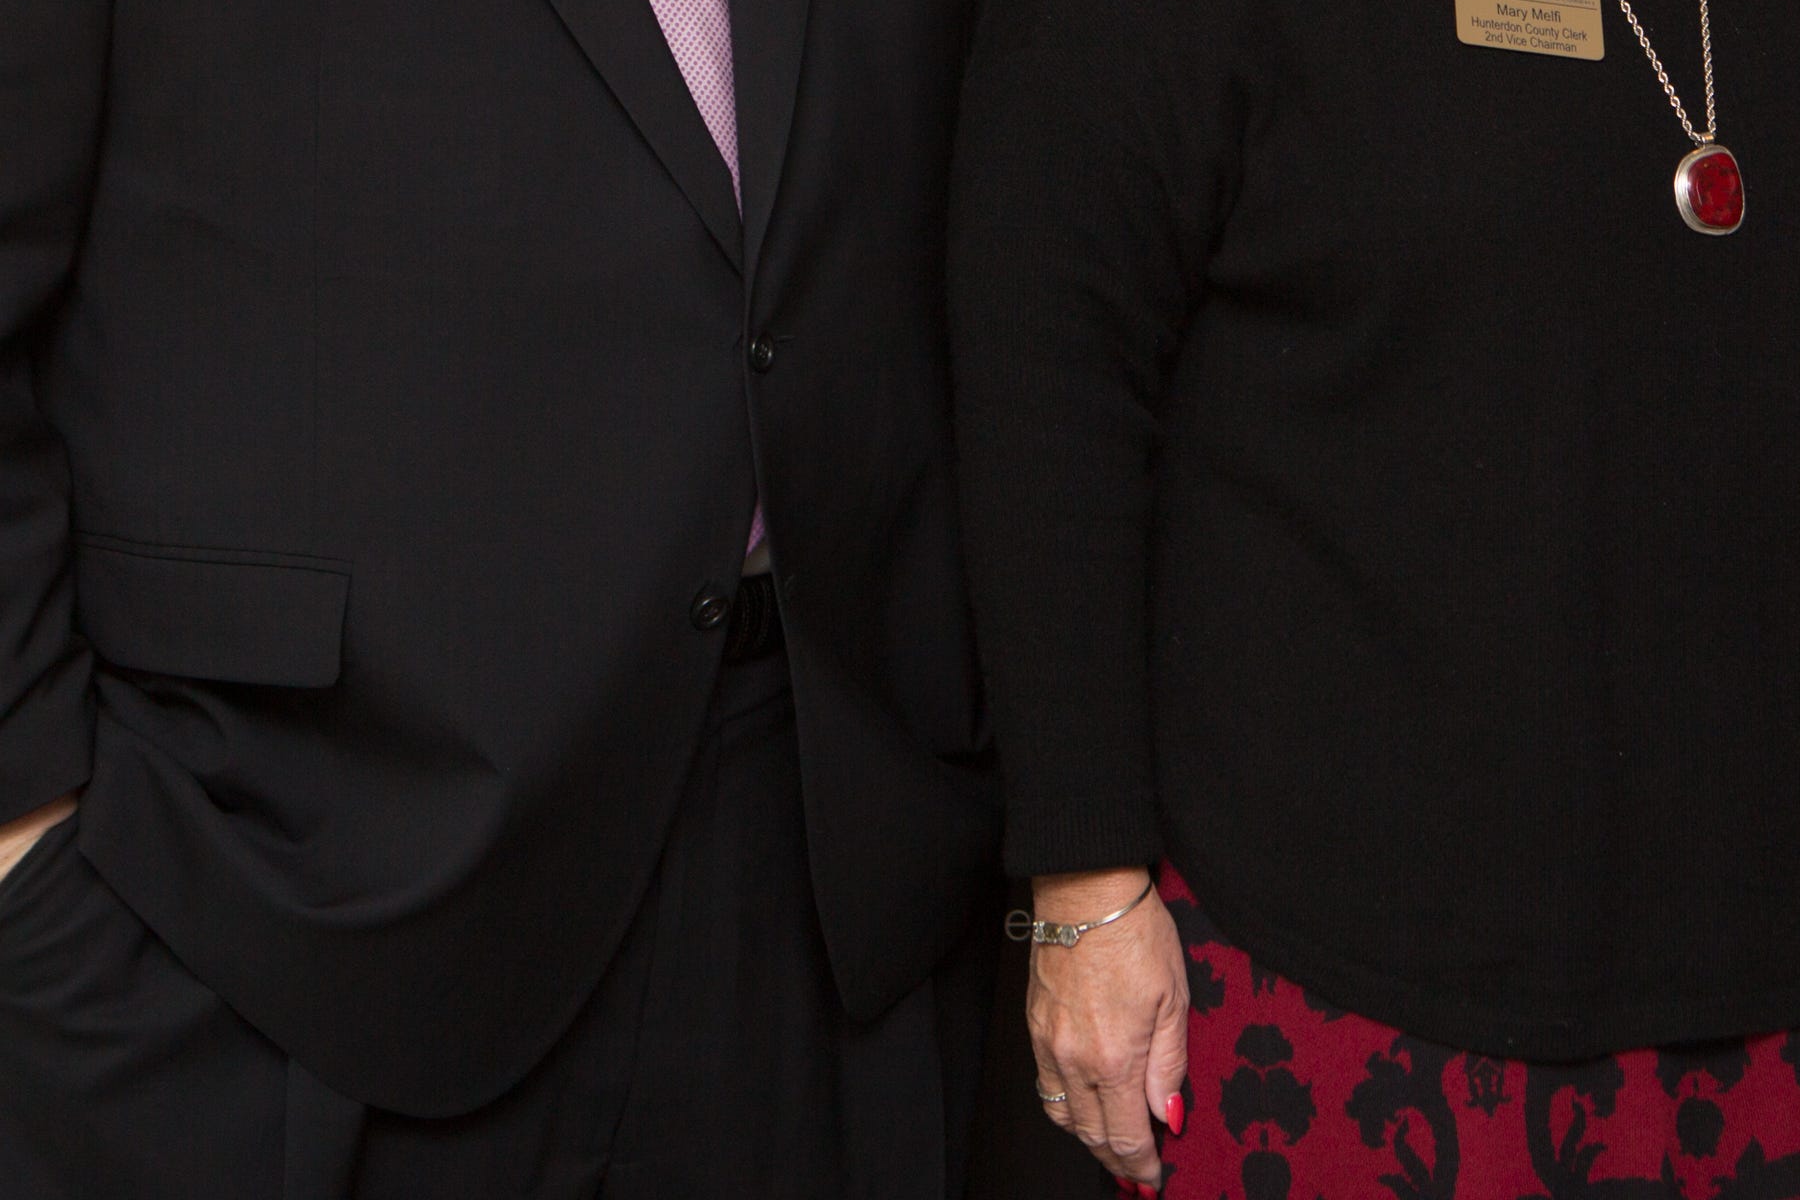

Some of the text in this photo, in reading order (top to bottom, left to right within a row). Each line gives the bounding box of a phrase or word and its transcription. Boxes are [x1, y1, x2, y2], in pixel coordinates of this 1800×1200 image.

[1496, 3, 1561, 23] Mary Melfi
[1471, 16, 1588, 41] Hunterdon County Clerk
[1485, 31, 1578, 53] 2nd Vice Chairman
